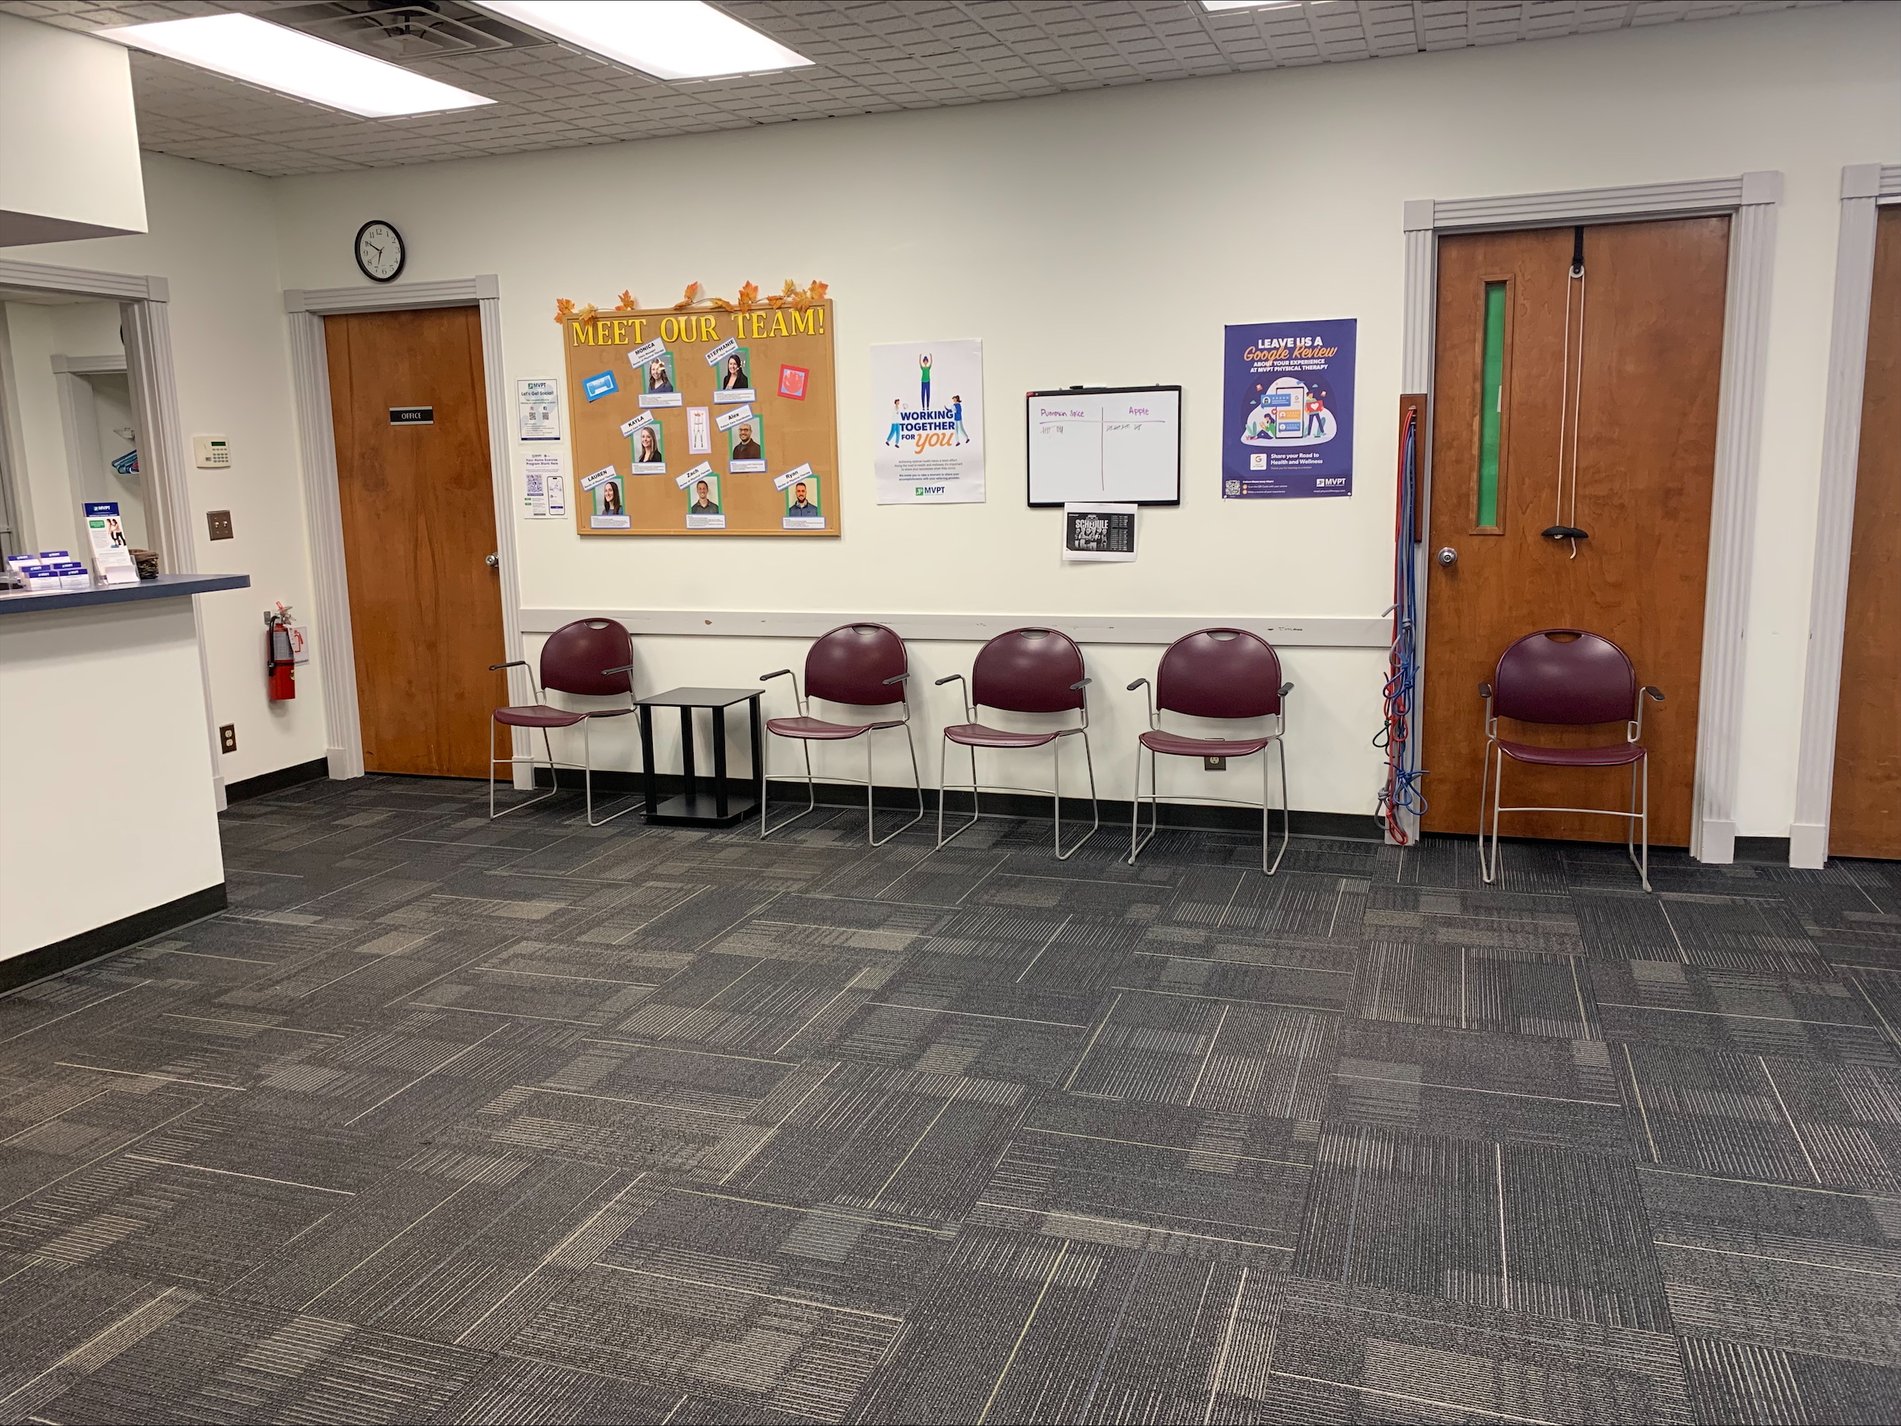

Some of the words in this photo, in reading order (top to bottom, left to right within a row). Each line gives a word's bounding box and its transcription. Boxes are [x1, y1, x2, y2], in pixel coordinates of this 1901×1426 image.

[572, 318, 646, 346] MEET
[660, 315, 720, 343] OUR
[732, 308, 825, 339] TEAM!
[1258, 338, 1294, 348] LEAVE
[1296, 337, 1312, 346] US
[1314, 336, 1323, 346] A
[634, 342, 655, 355] MONICA
[707, 340, 734, 360] STEPHANIE
[1244, 346, 1290, 365] Google
[1292, 345, 1338, 358] Review
[900, 410, 954, 420] WORKING
[1128, 406, 1150, 416] Apple
[628, 416, 644, 427] KAYLA
[900, 422, 956, 432] TOGETHER
[914, 432, 954, 454] you
[588, 470, 608, 482] LAUREN
[786, 471, 798, 479] Ryan
